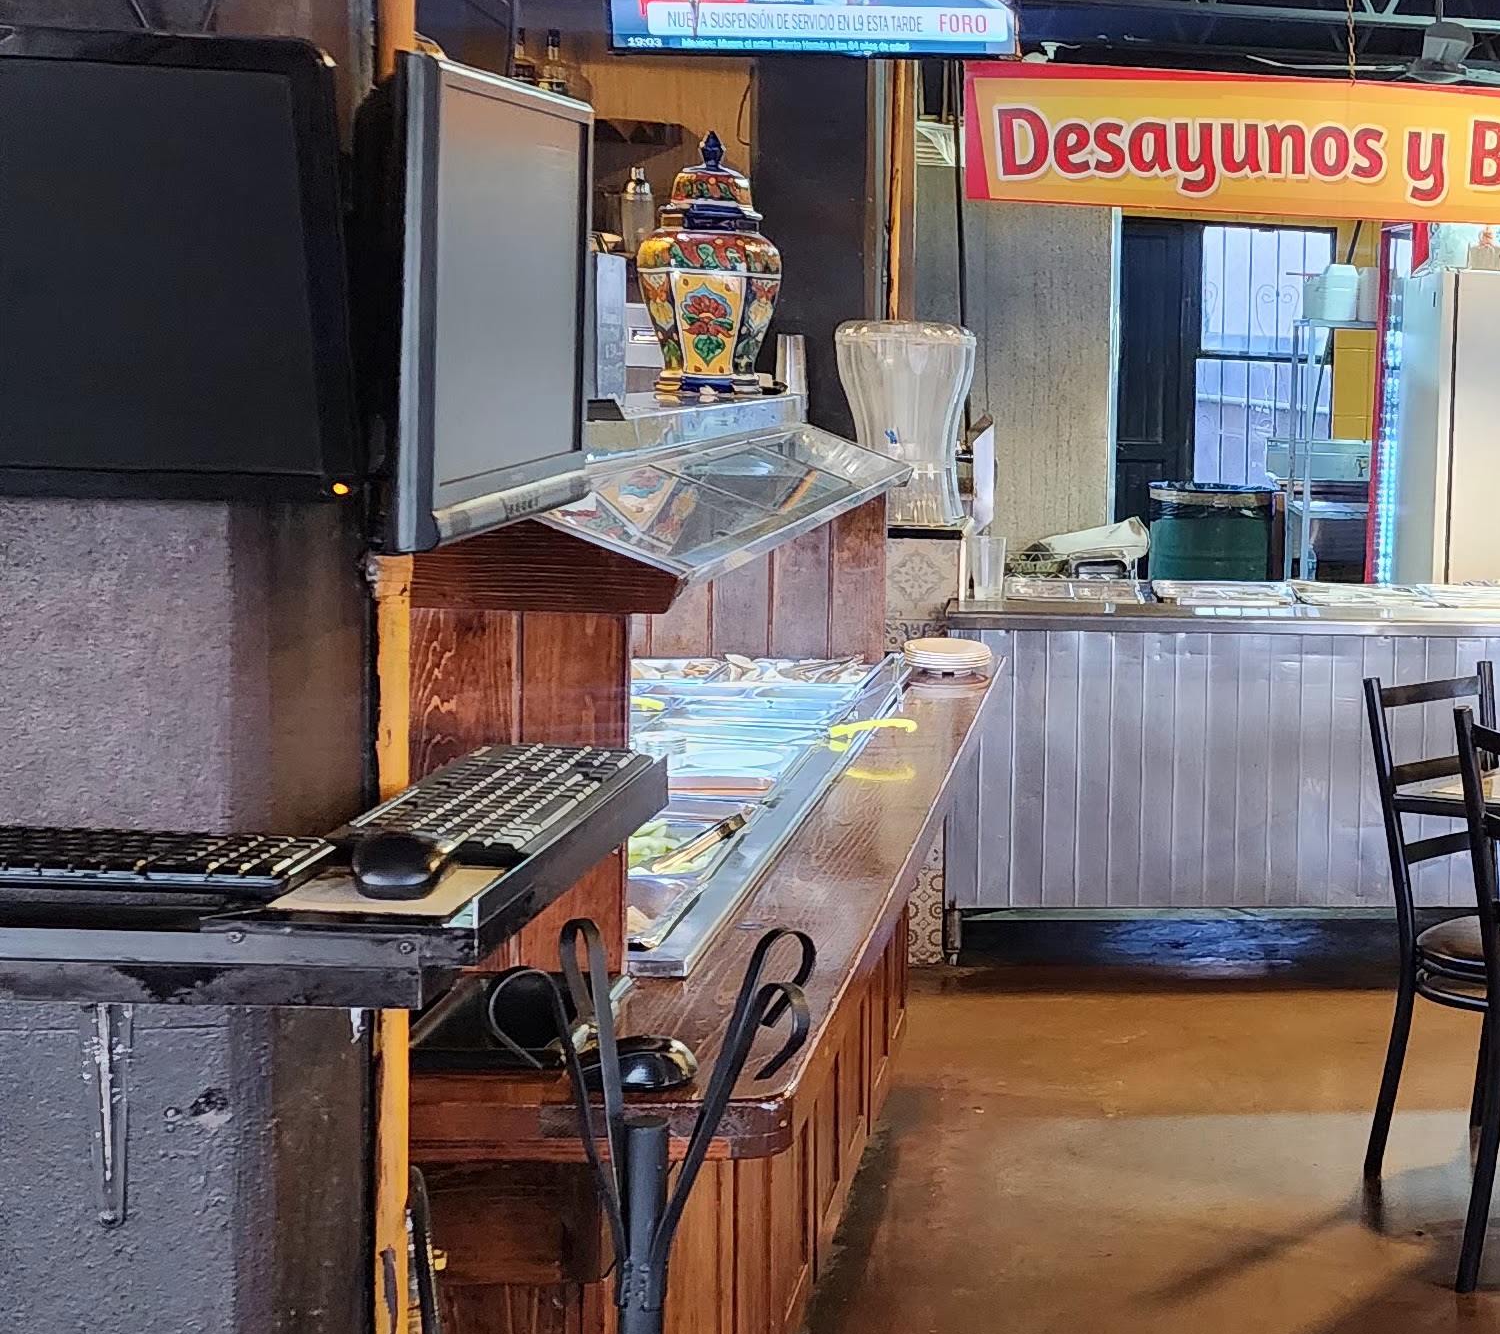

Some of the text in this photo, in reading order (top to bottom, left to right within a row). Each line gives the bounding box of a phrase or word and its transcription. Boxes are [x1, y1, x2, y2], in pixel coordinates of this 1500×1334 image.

[667, 10, 708, 28] NUEA
[711, 9, 775, 30] SUSPENSIÓN
[777, 14, 790, 30] DE
[792, 13, 835, 31] SERVICIO
[838, 15, 850, 31] EN
[866, 16, 889, 32] ESTA
[891, 16, 924, 33] TARDE
[939, 14, 988, 34] FORO
[996, 106, 1386, 194] Desayunos
[1405, 129, 1447, 203] y
